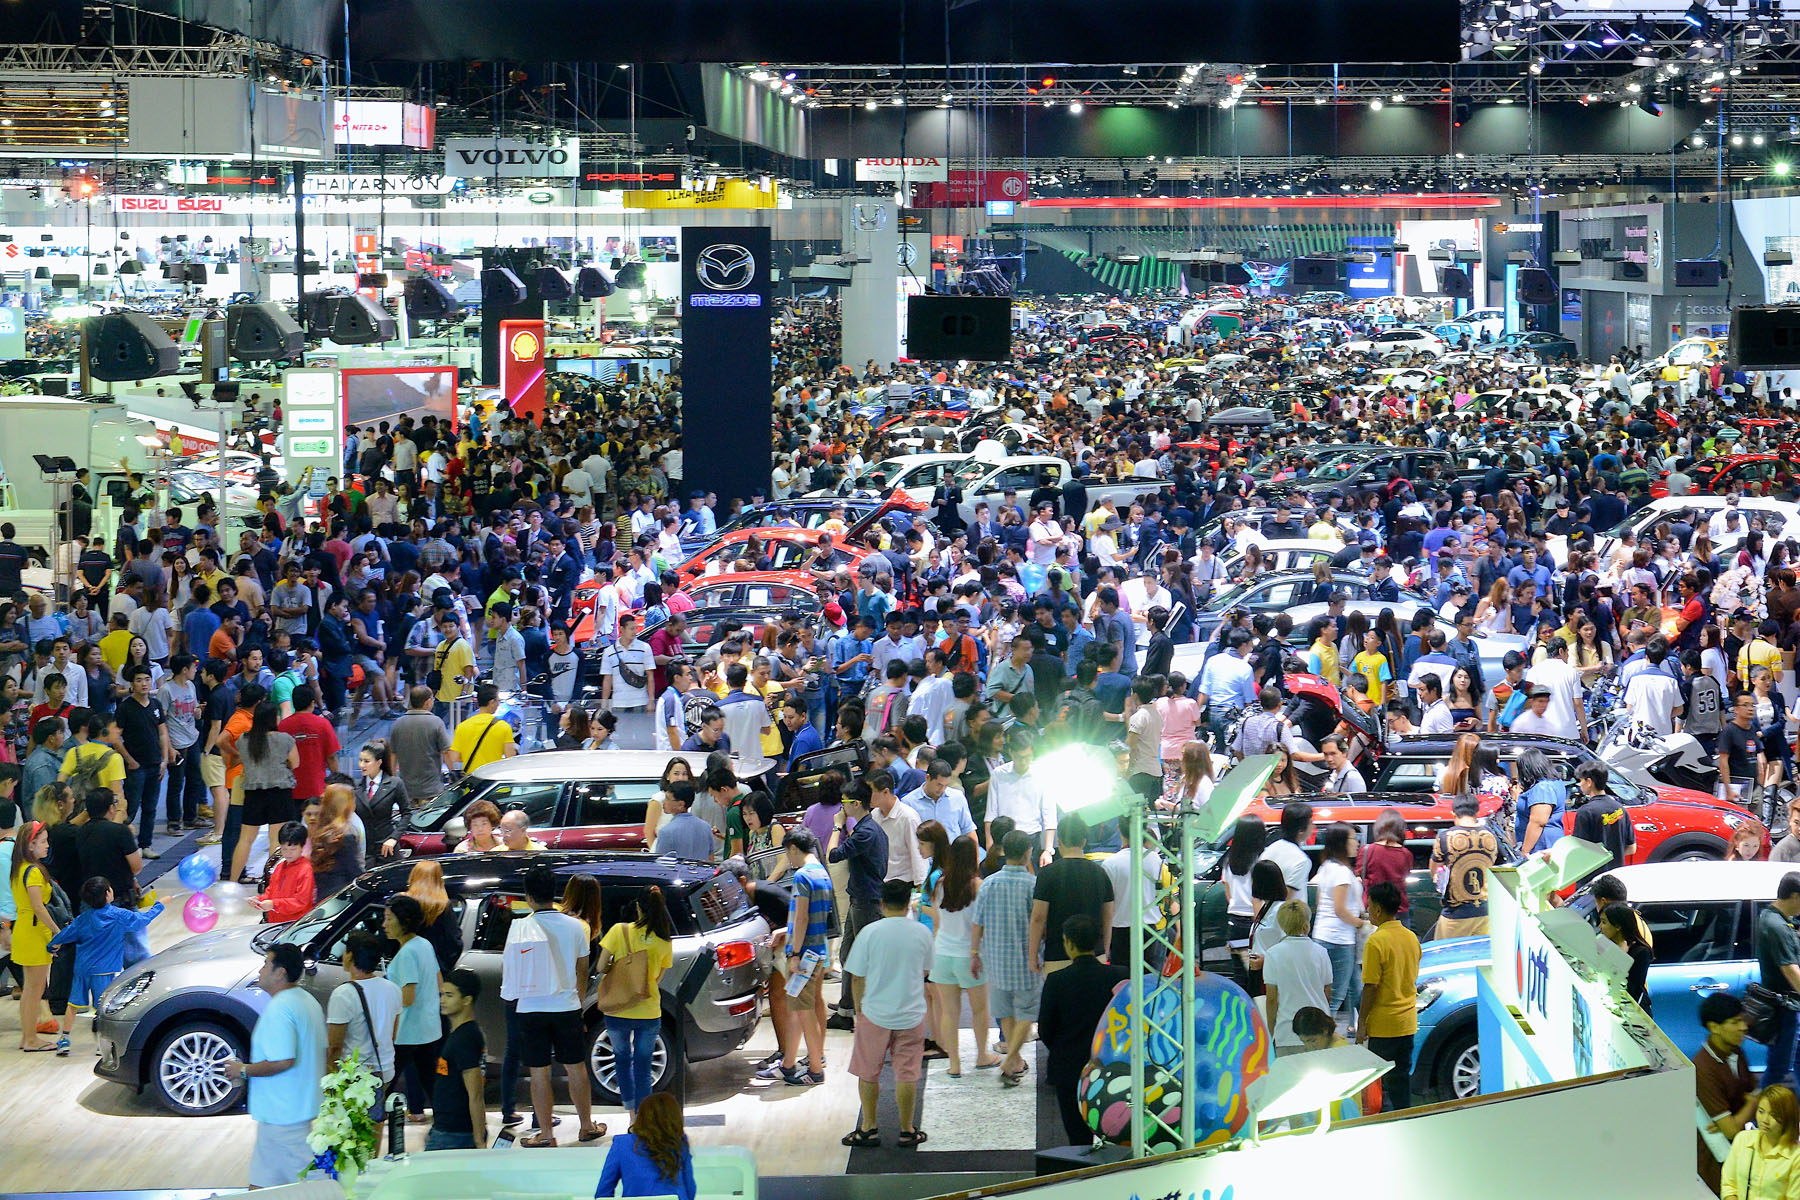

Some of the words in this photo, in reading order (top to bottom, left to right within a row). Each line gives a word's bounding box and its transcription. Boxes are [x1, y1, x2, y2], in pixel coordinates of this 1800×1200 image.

[456, 149, 568, 165] VOLVO
[865, 157, 941, 167] HONDA
[586, 173, 676, 182] PORSCHE
[306, 178, 440, 191] THAIYARNYON
[121, 198, 168, 210] ISUZU
[177, 199, 222, 211] ISUZU
[695, 194, 726, 204] DUCATI
[1697, 689, 1716, 714] 53
